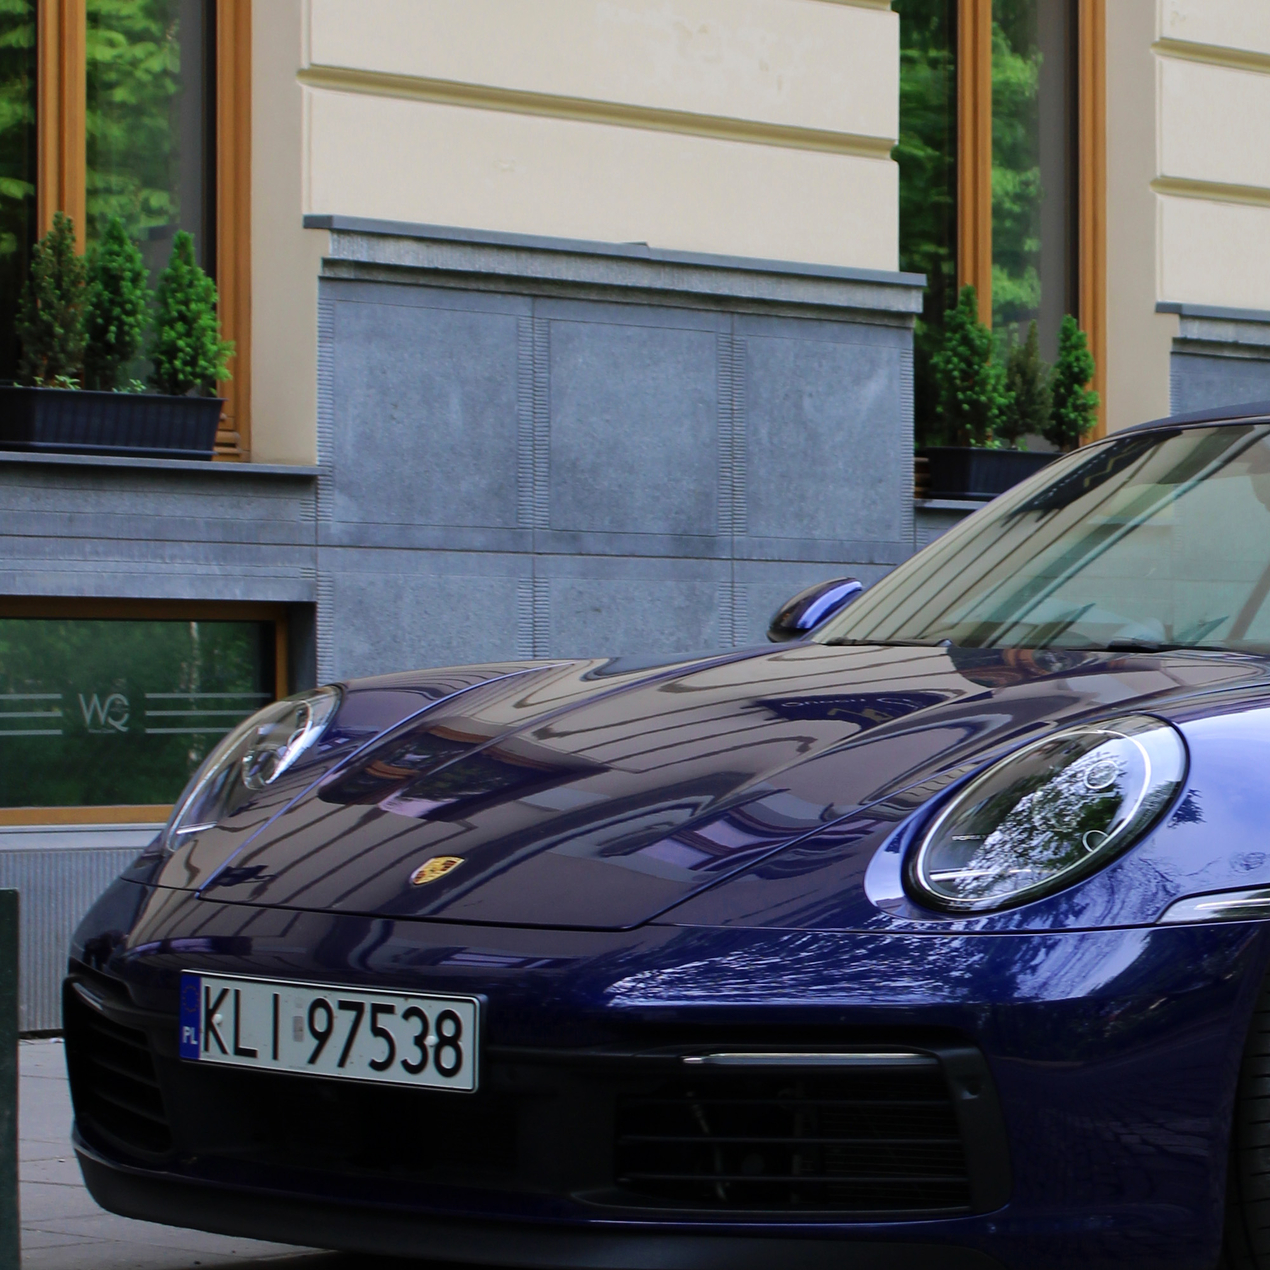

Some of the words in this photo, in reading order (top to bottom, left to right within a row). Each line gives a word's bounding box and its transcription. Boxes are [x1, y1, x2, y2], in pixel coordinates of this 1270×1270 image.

[182, 1026, 198, 1045] PL
[203, 985, 280, 1061] KLI
[307, 997, 463, 1078] 97538
